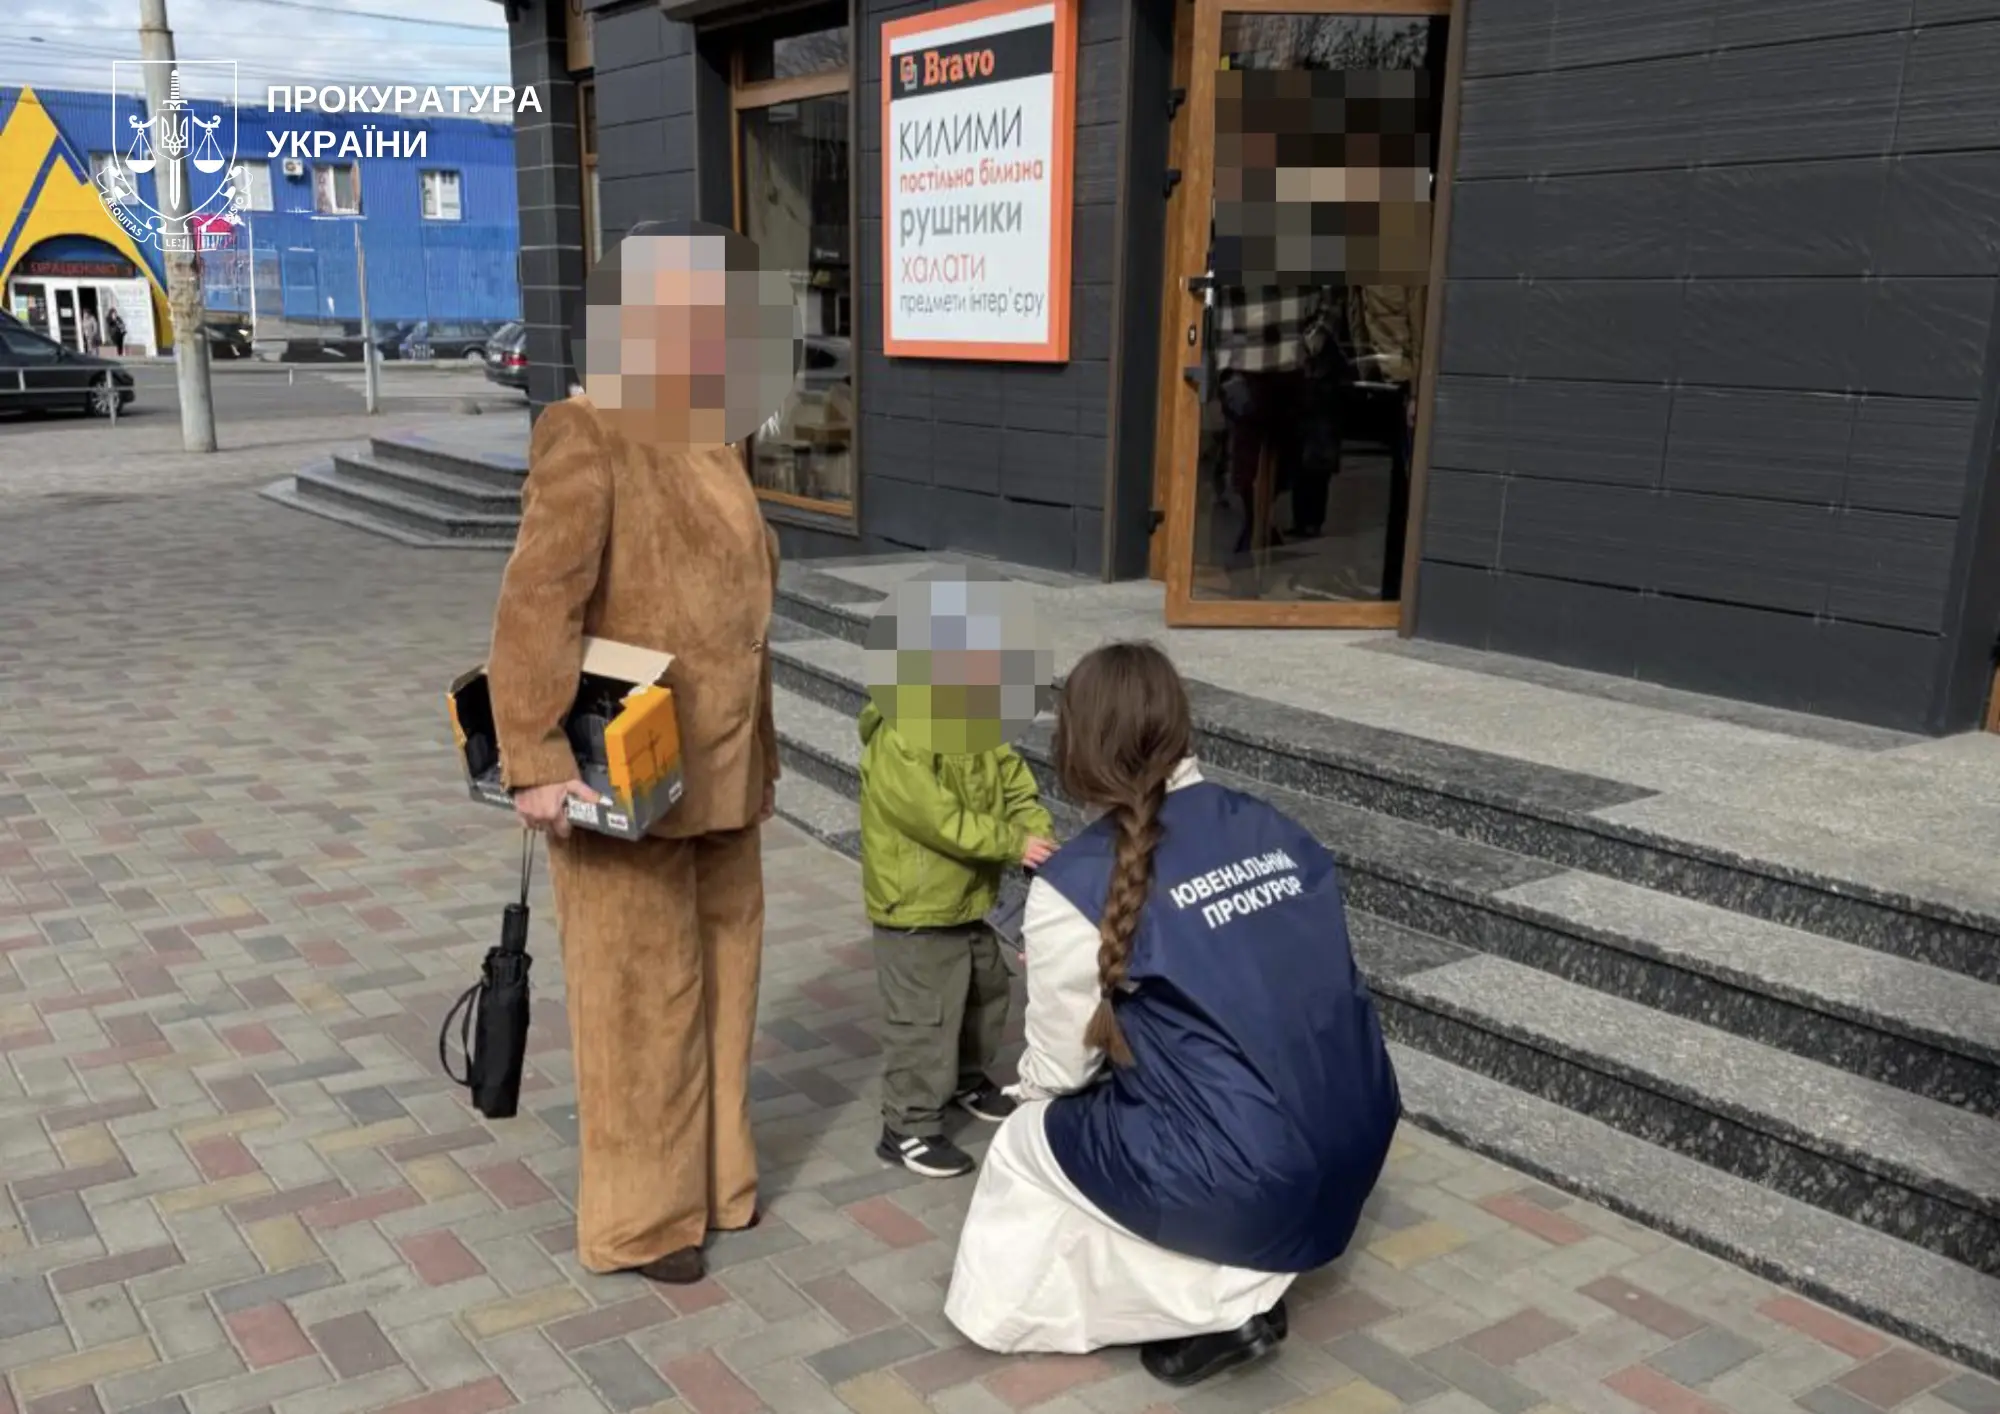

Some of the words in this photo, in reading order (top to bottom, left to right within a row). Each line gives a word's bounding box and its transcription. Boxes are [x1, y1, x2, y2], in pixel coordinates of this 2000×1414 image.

[923, 48, 995, 86] Bravo
[899, 164, 975, 194] постільна
[978, 156, 1044, 187] білизна
[899, 200, 1022, 248] рушники
[901, 253, 986, 284] халати
[899, 292, 967, 319] предмети
[1201, 875, 1304, 930] ПРОКУРОР
